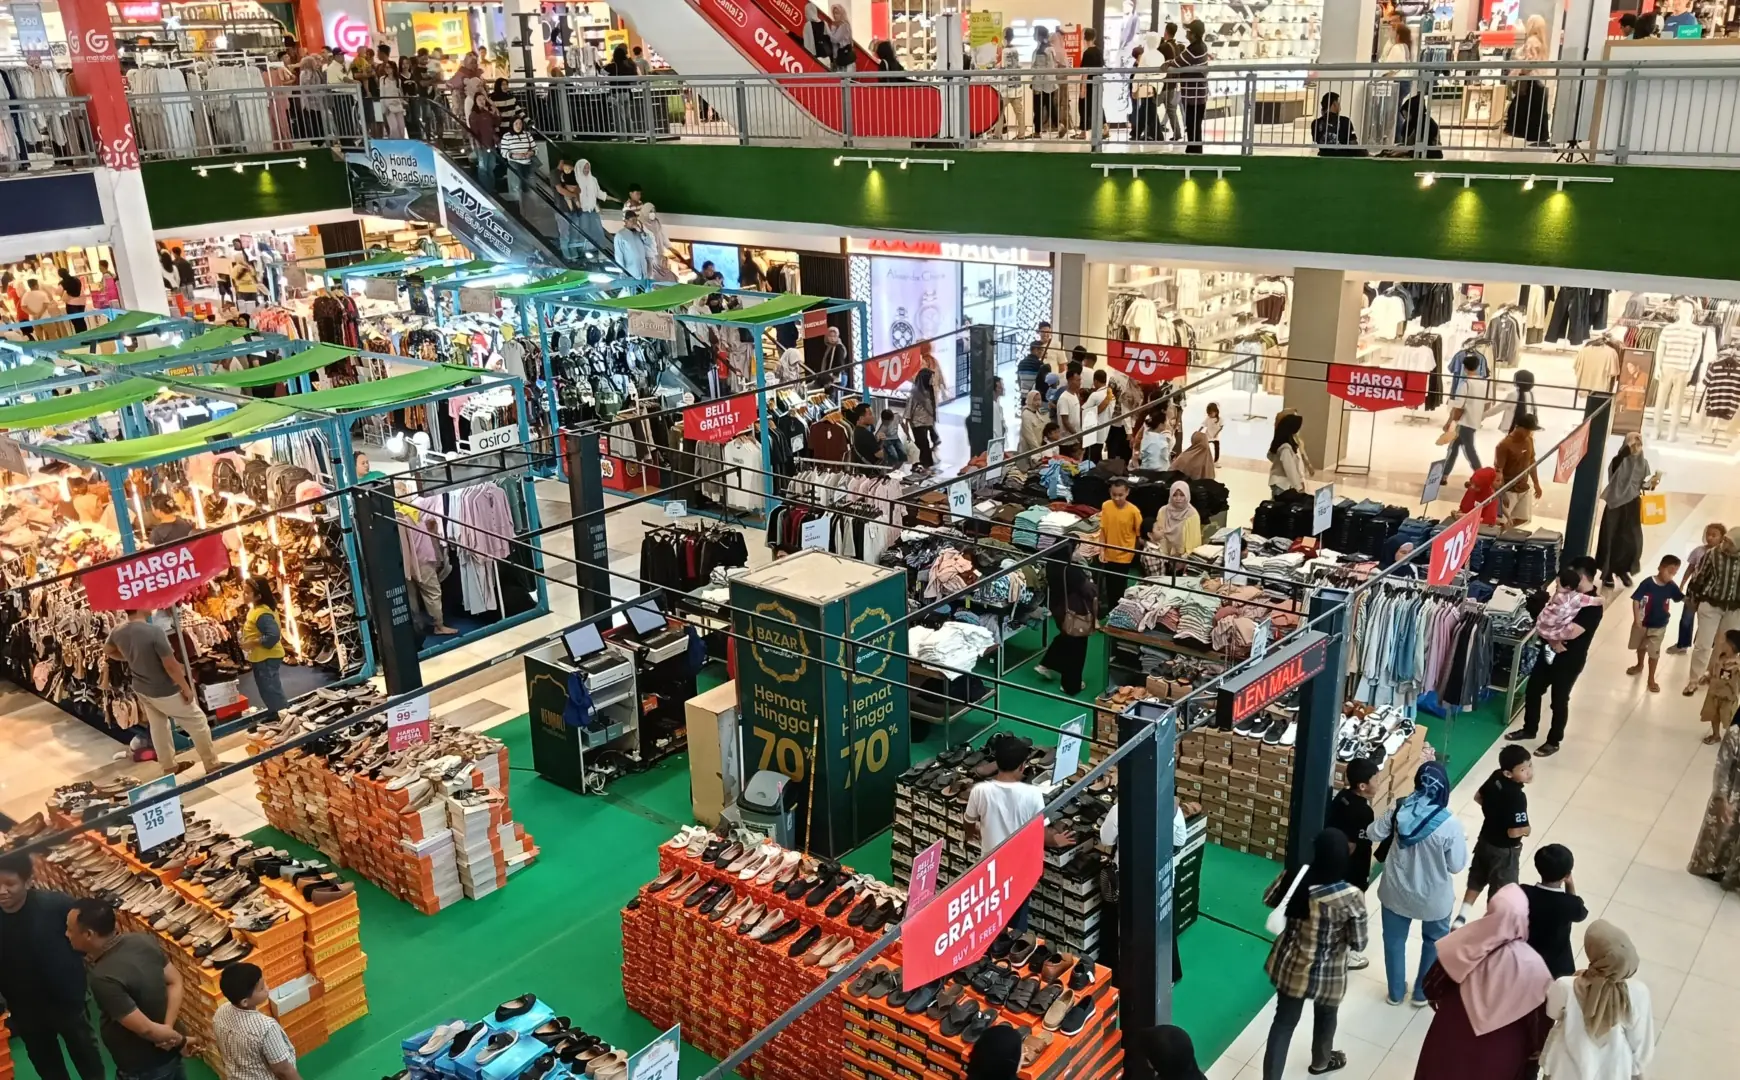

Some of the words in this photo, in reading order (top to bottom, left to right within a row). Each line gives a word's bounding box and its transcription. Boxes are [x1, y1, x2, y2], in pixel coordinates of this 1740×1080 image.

[718, 0, 737, 18] antai
[738, 12, 744, 22] 2
[774, 0, 792, 17] antai
[793, 11, 799, 21] 2
[389, 153, 417, 168] Honda
[391, 169, 436, 186] RoadSync
[1350, 371, 1404, 389] HARGA
[1346, 384, 1405, 402] SPESIAL
[705, 404, 724, 418] BELI
[726, 400, 731, 412] 1
[699, 413, 734, 431] GRATIS
[478, 429, 511, 449] asiro
[116, 547, 194, 583] HARGA
[117, 563, 201, 600] SPESIAL
[756, 626, 798, 650] BAZAR
[1269, 657, 1305, 697] MALL
[754, 684, 808, 715] Hemat
[842, 684, 892, 719] Hemat
[396, 711, 411, 722] 99
[754, 701, 811, 734] Hingga
[841, 701, 894, 737] Hingga
[396, 732, 422, 743] SPESIAL
[397, 727, 421, 737] HARGA
[143, 806, 163, 821] 175
[1515, 812, 1527, 823] 23
[145, 816, 165, 831] 219
[916, 862, 935, 880] GRATIS
[917, 859, 930, 873] BELI
[921, 875, 927, 890] 1
[948, 877, 984, 923] BELI
[987, 859, 996, 889] 1
[934, 889, 1000, 957] GRATIS
[952, 946, 968, 966] BUY
[969, 931, 976, 951] 1
[979, 925, 996, 943] FREE
[996, 908, 1003, 928] 1
